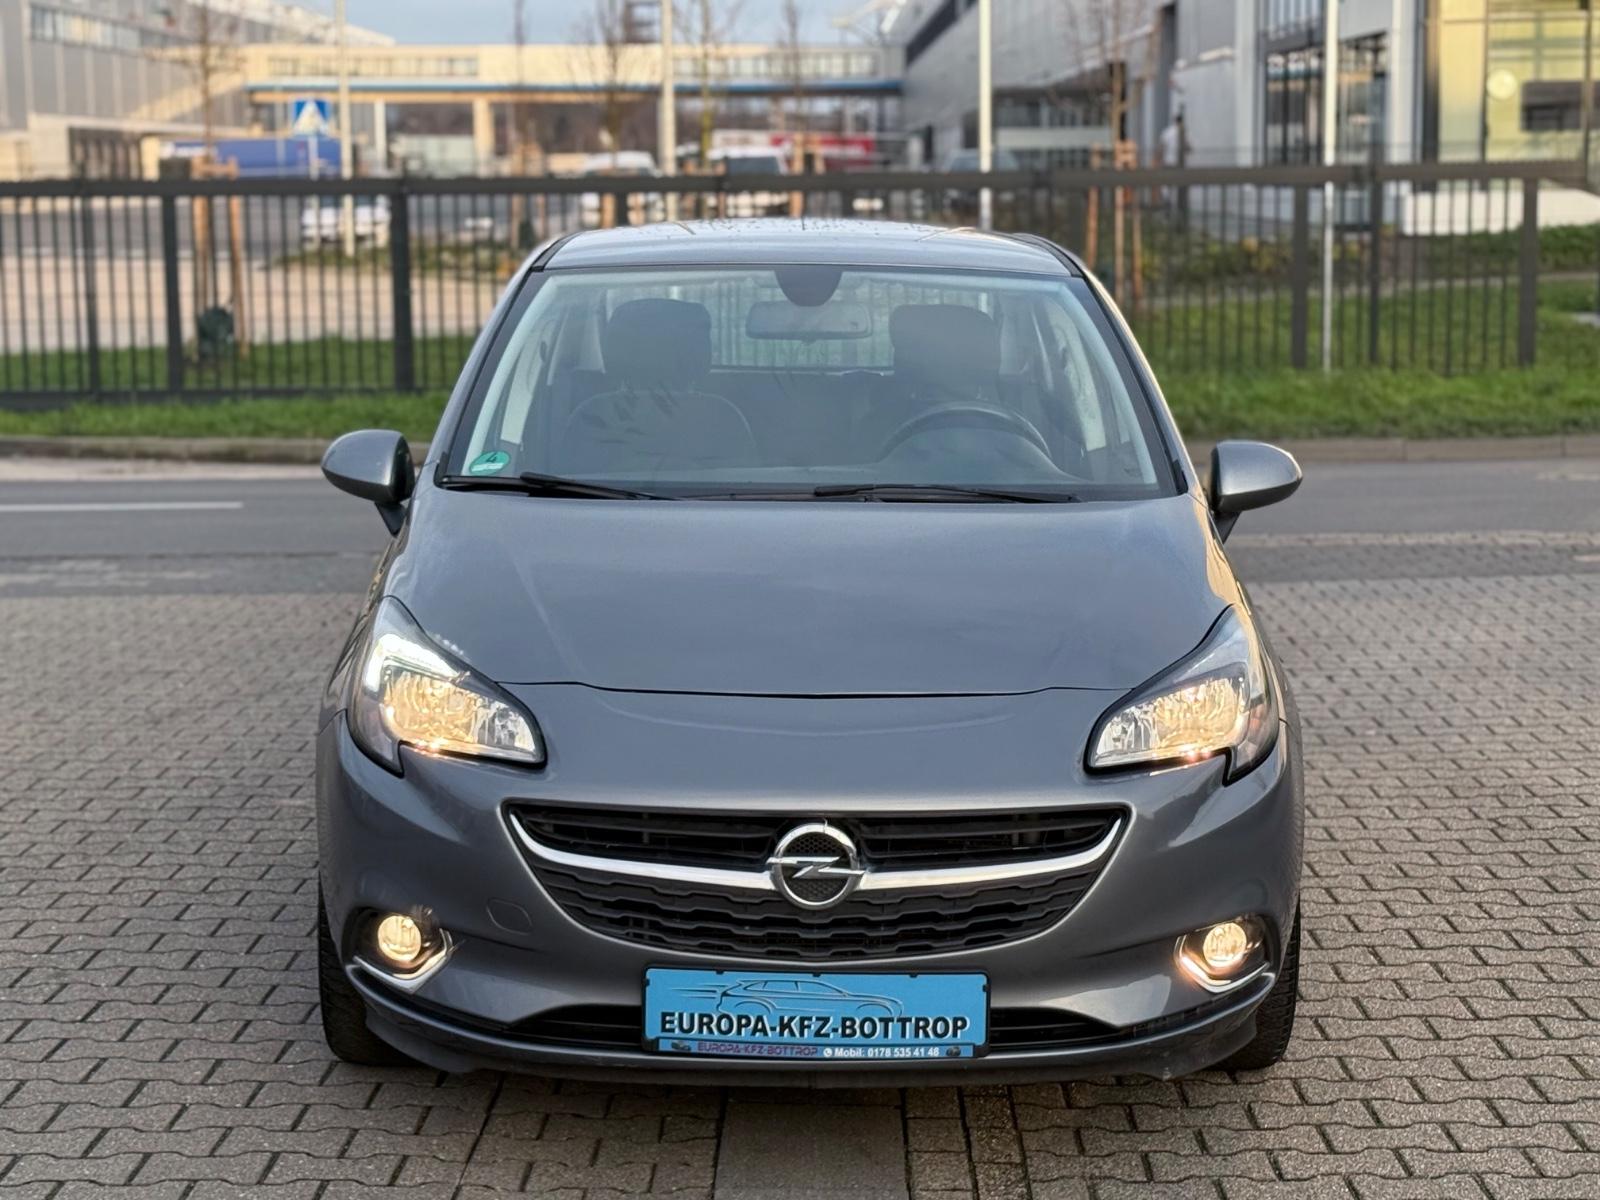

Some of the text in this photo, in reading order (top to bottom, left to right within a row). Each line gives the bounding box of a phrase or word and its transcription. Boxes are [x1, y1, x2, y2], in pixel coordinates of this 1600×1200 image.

[660, 1011, 970, 1040] EUROPA-KFZ-BOTTROP
[834, 1047, 865, 1057] Mobil:
[867, 1047, 891, 1058] 0178
[893, 1047, 911, 1057] 535
[913, 1047, 925, 1057] 41
